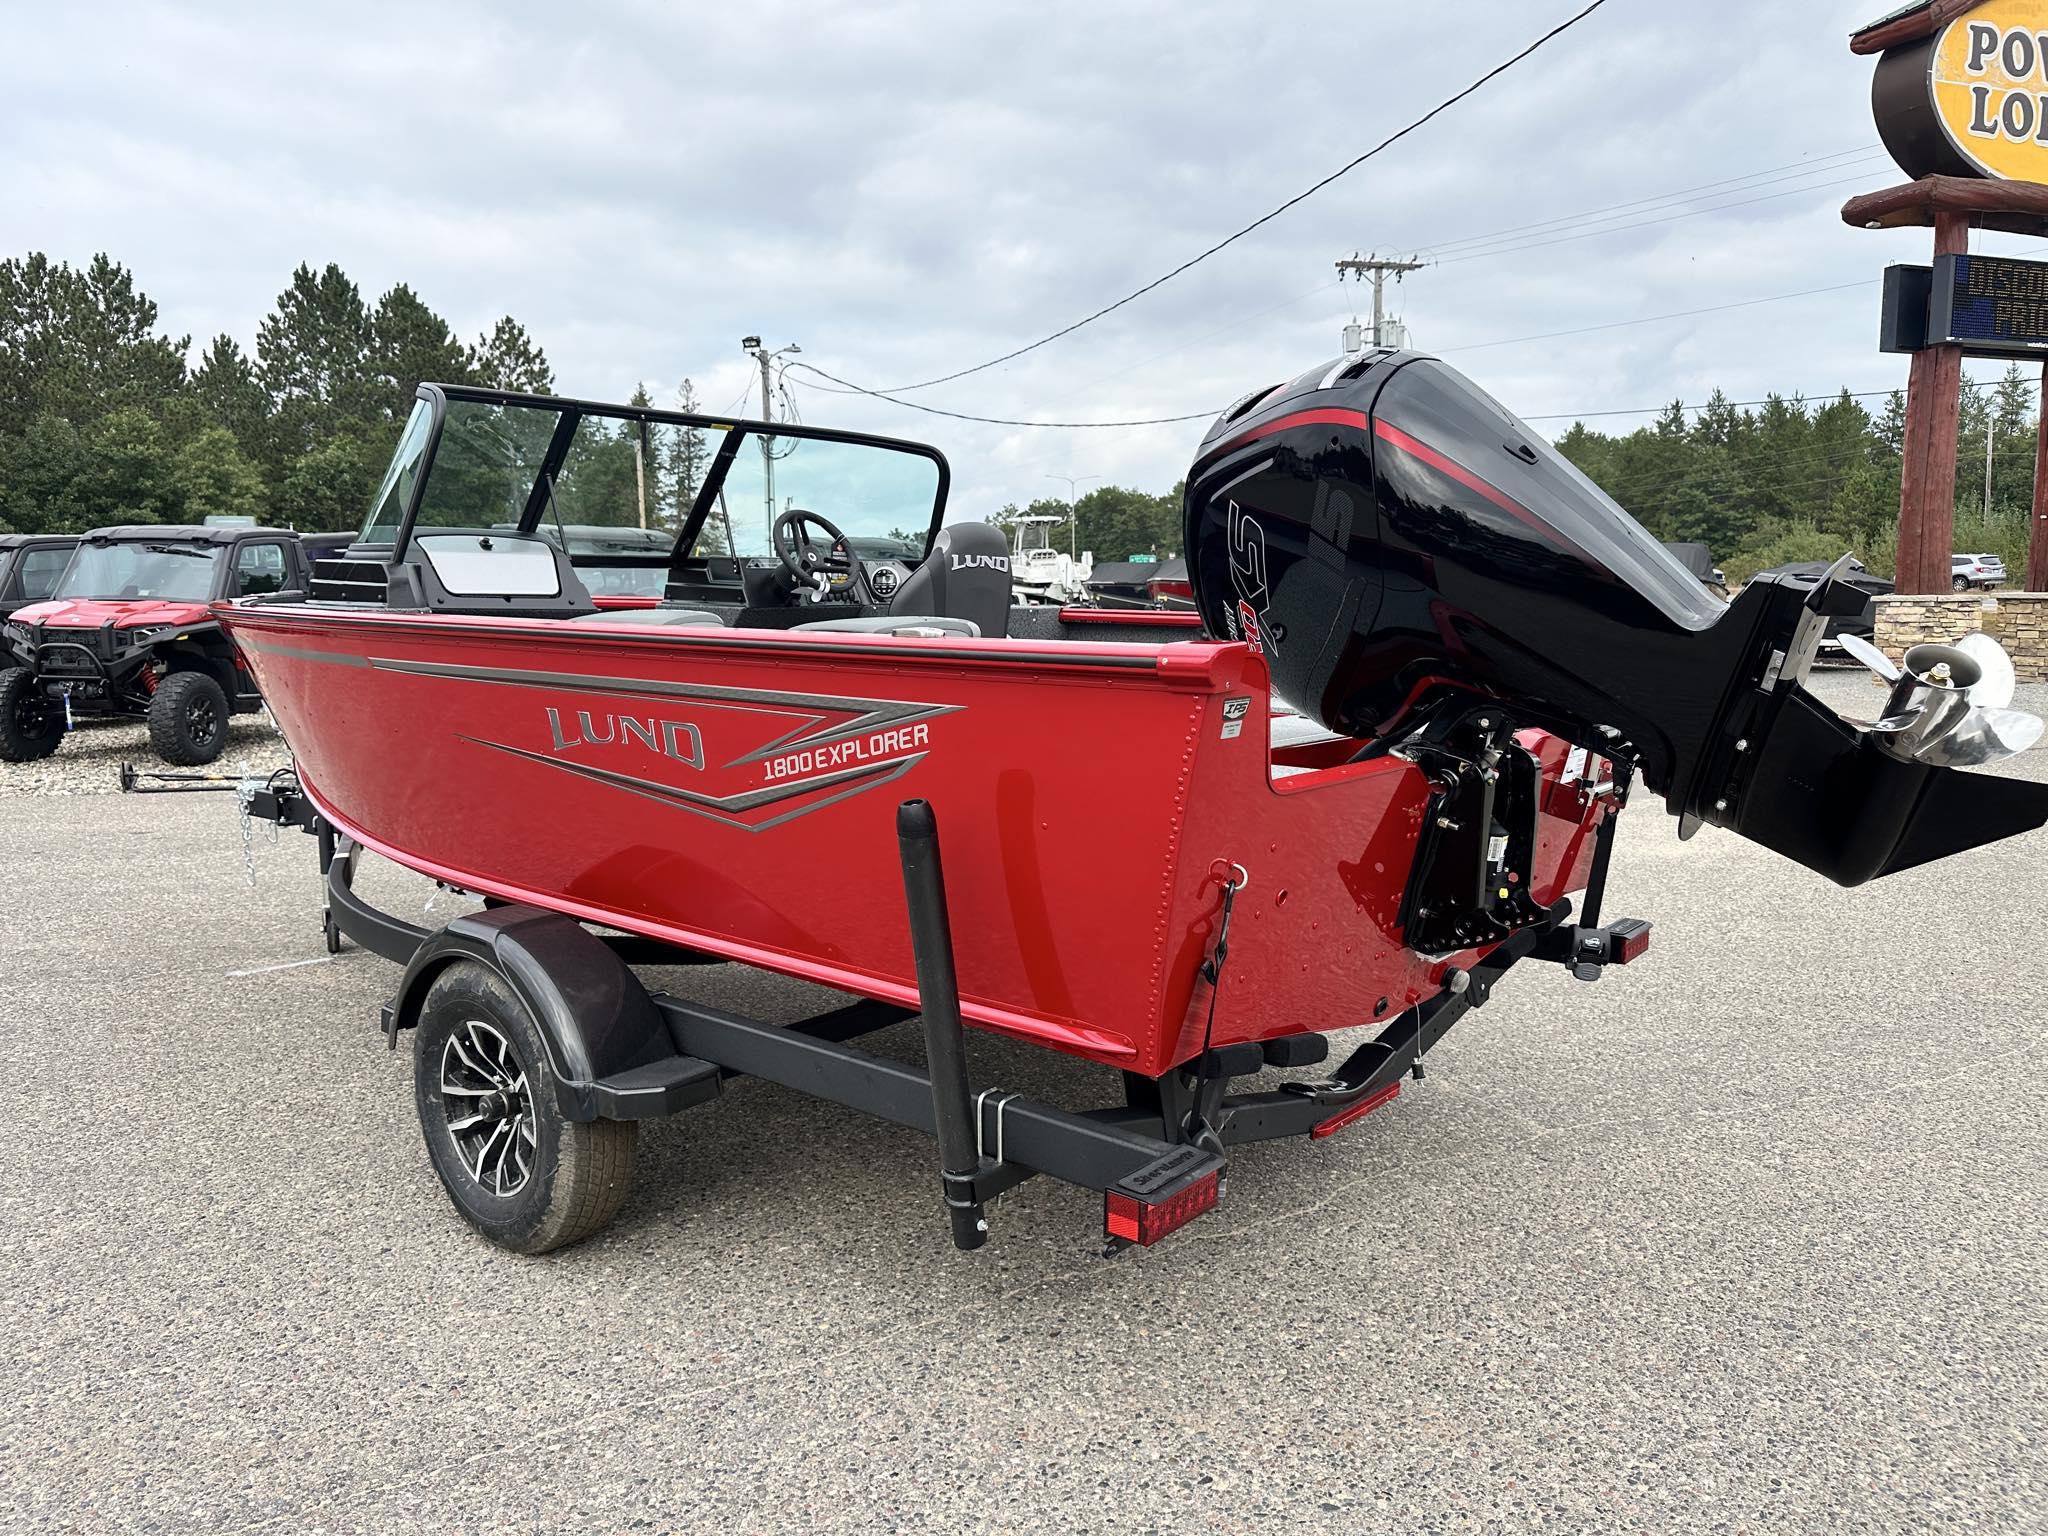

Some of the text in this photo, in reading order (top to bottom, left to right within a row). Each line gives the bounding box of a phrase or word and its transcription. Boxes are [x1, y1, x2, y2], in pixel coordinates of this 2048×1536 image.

[1967, 24, 2048, 82] PO
[951, 554, 1009, 573] LUND
[1225, 702, 1248, 714] IPS
[545, 707, 705, 771] LUND
[763, 723, 929, 781] 1800 EXPLORER
